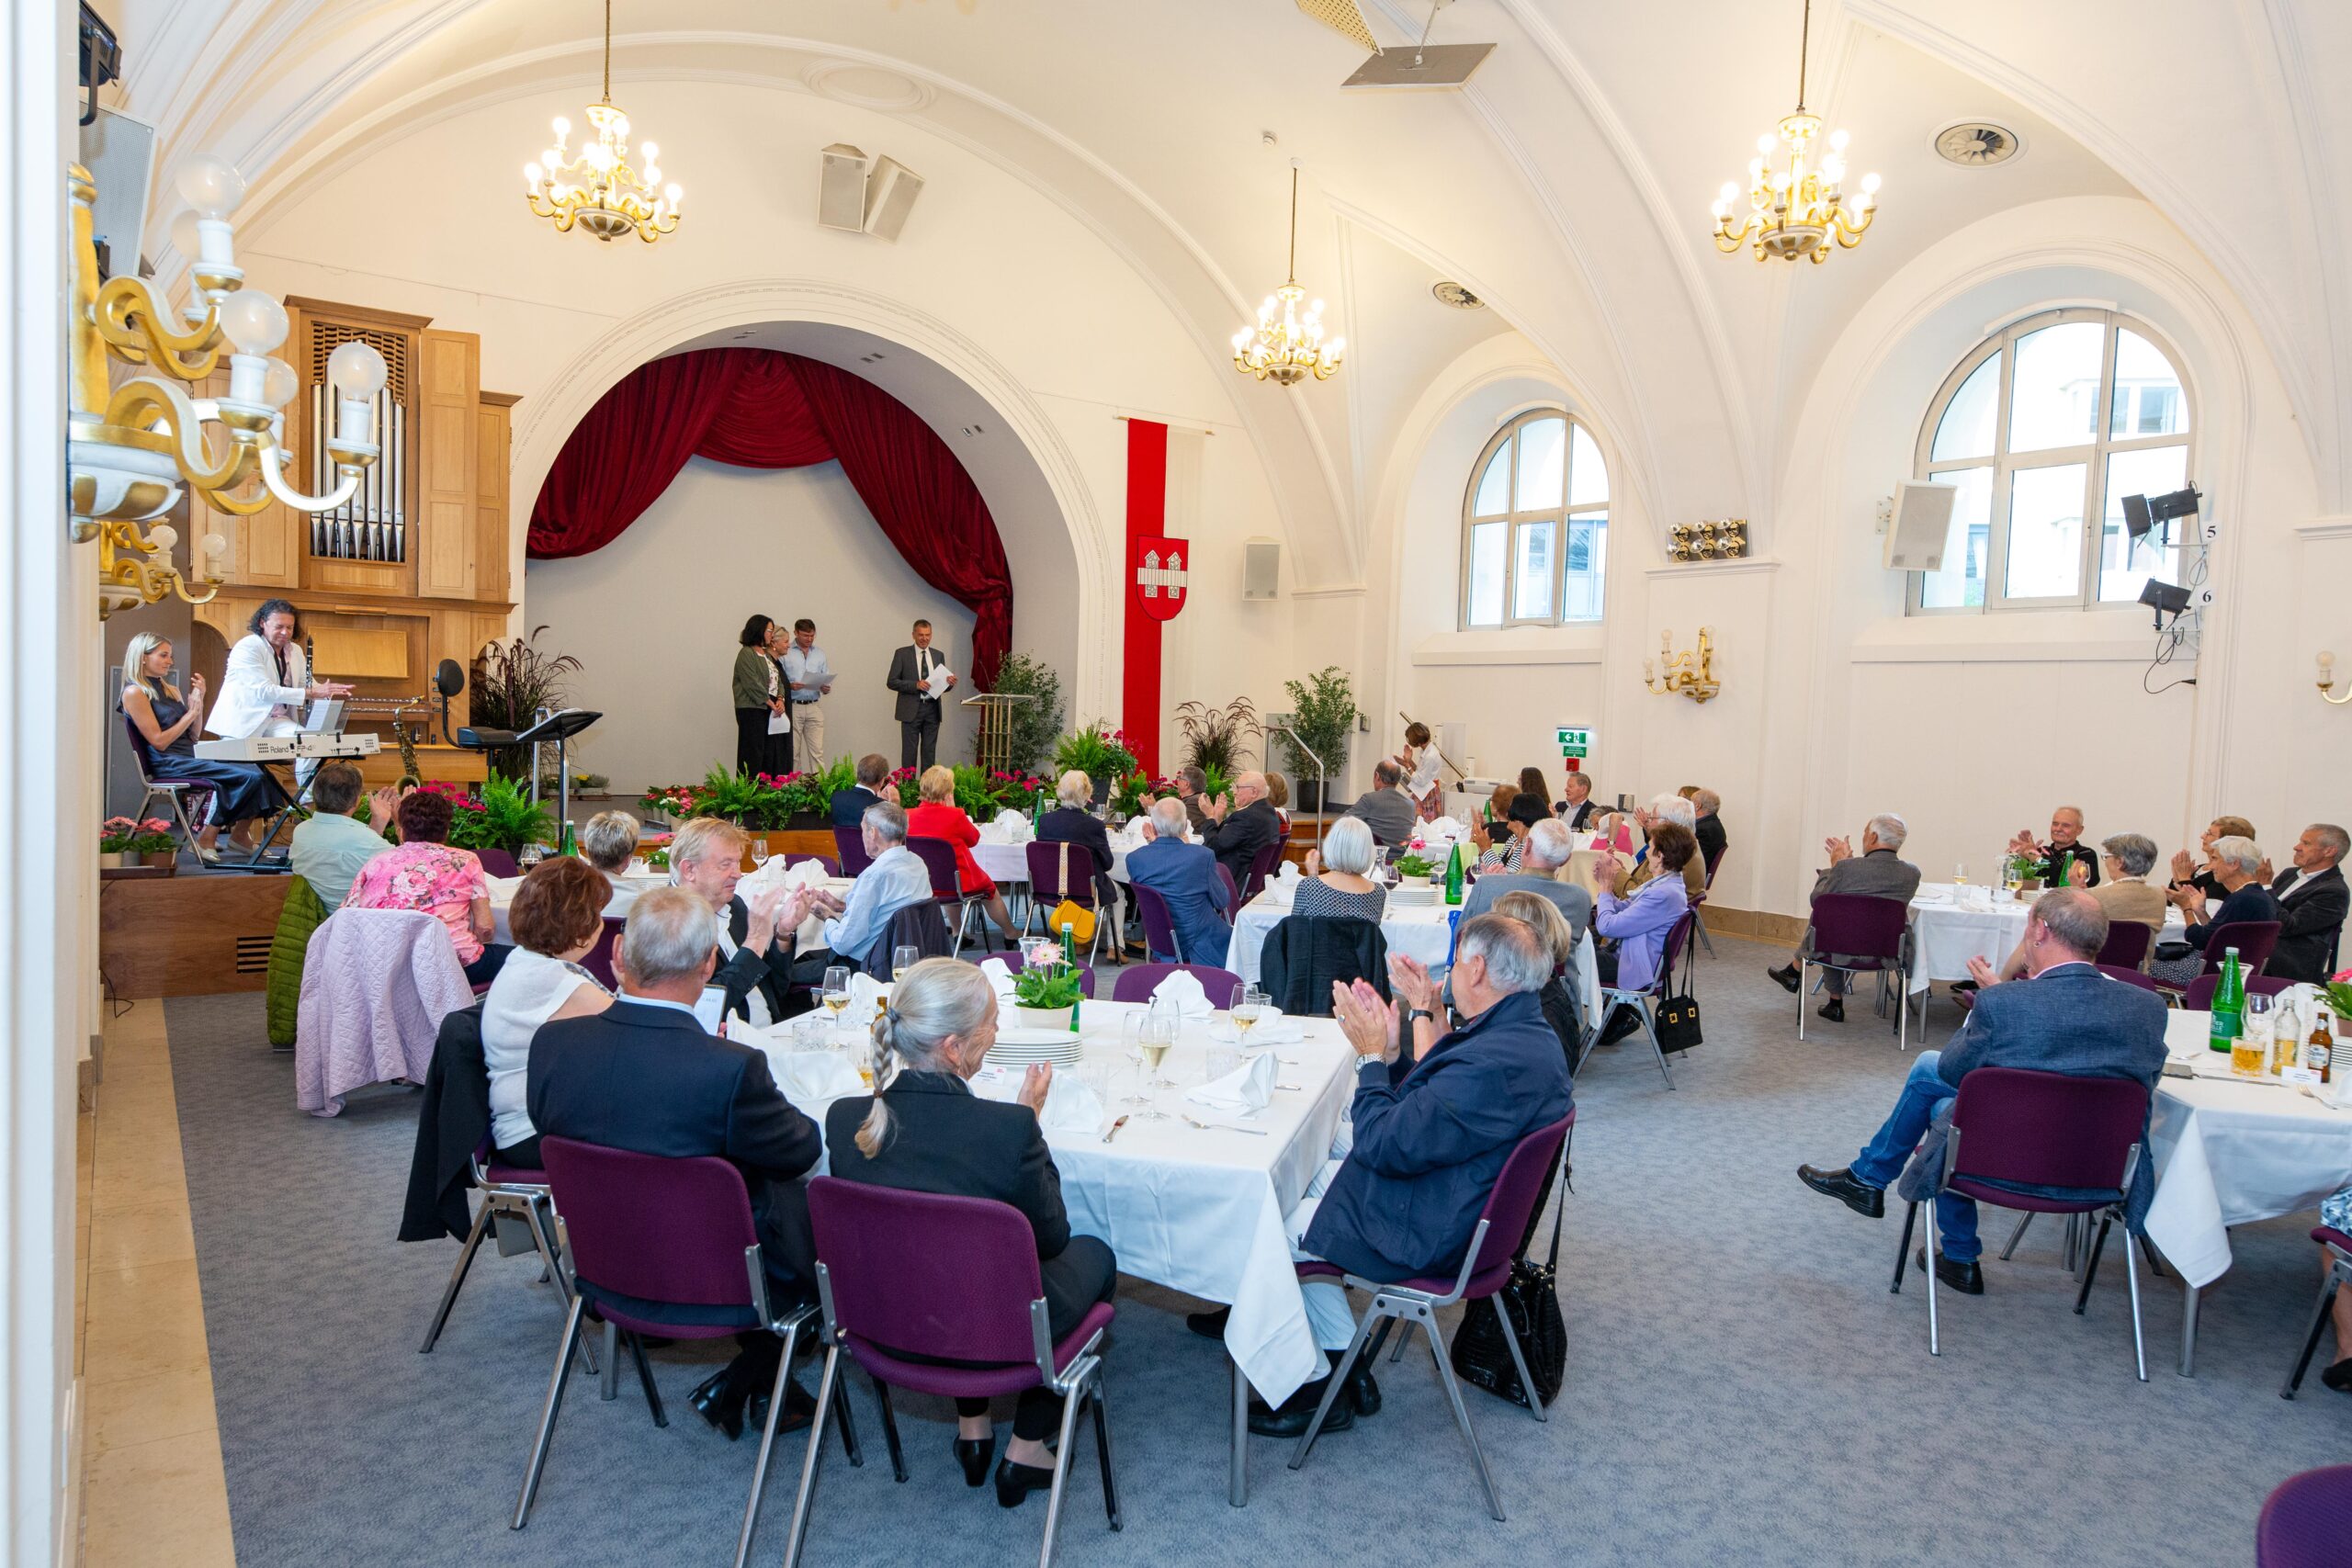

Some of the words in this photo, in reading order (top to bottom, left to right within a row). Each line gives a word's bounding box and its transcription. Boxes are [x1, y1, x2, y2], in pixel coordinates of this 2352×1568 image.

[2207, 525, 2216, 538] 5
[2202, 590, 2212, 603] 6
[270, 745, 289, 753] Roland
